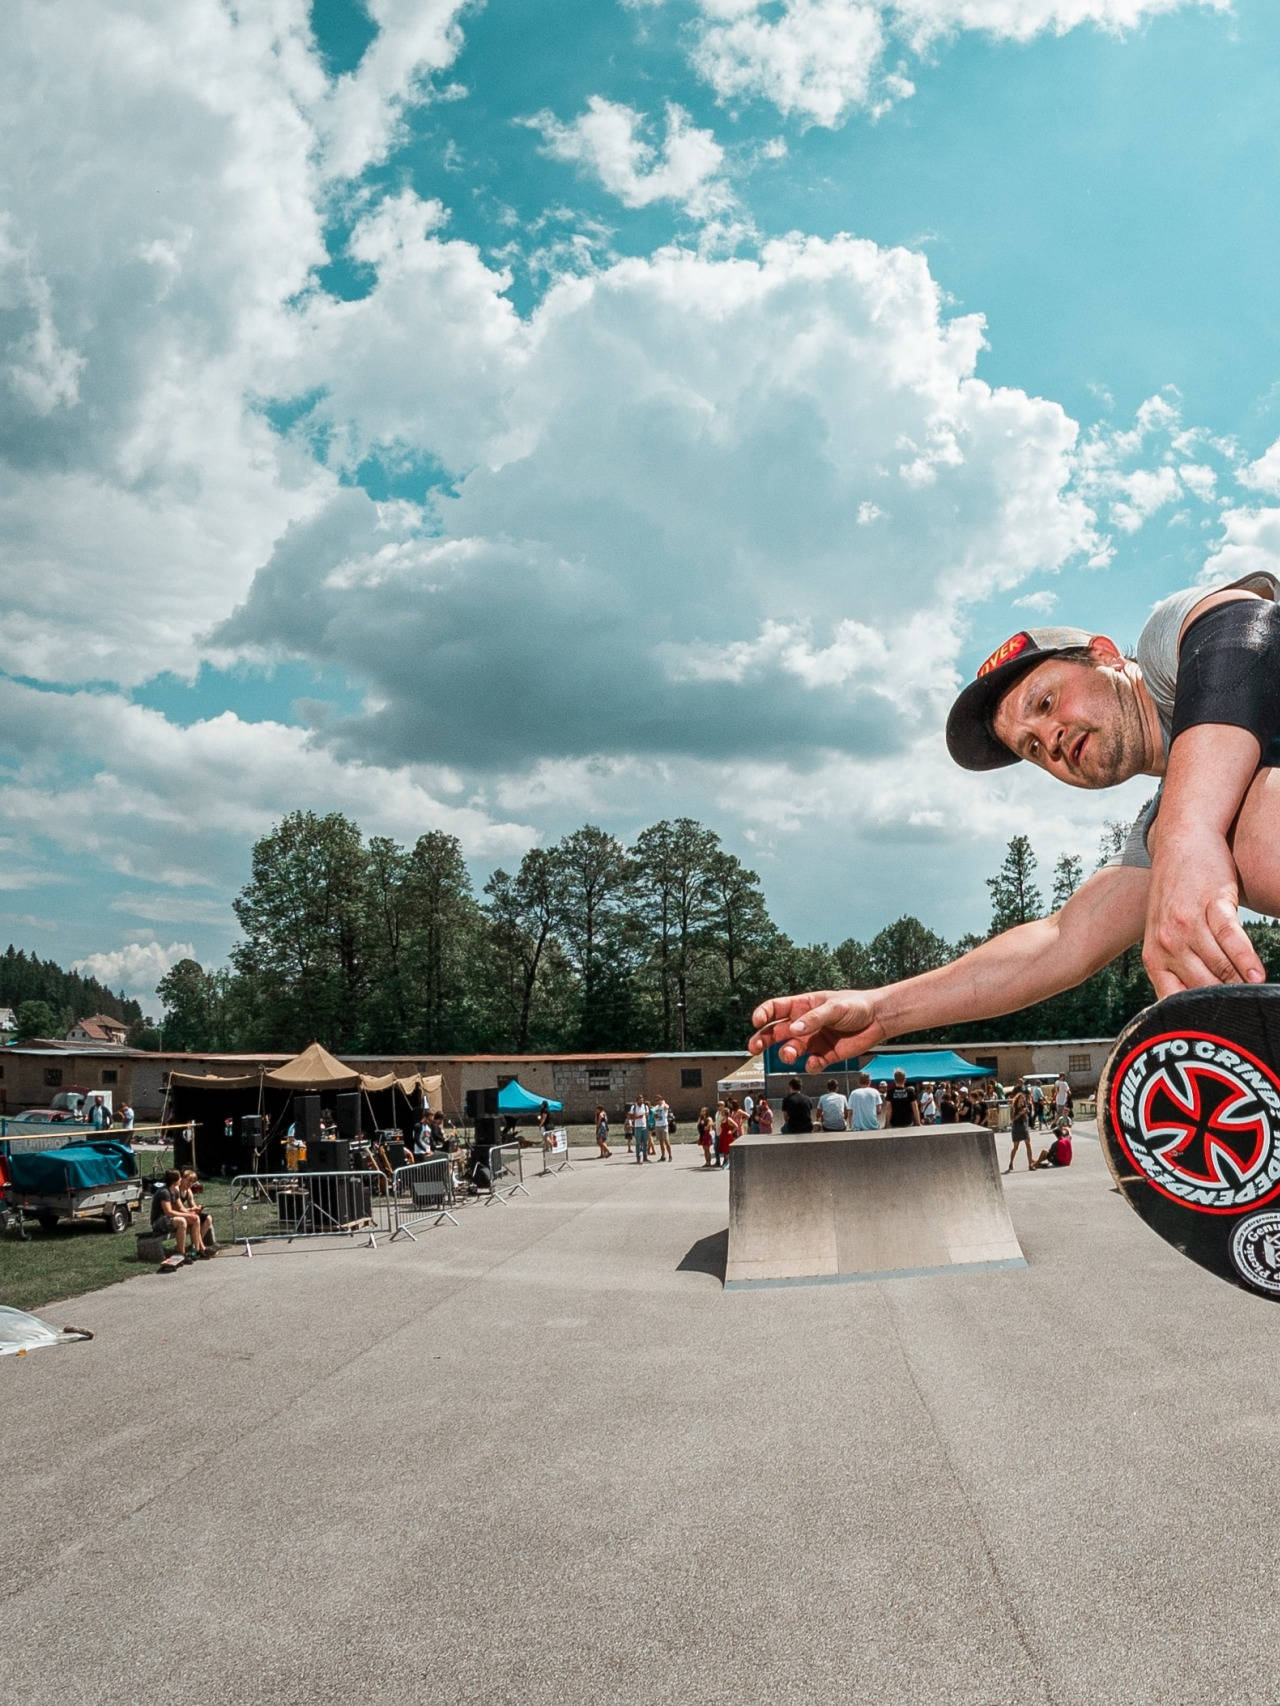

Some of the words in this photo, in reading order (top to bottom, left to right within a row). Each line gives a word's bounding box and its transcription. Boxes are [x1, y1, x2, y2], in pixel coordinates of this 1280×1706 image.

[1120, 1052, 1148, 1129] BUILT
[1151, 1039, 1188, 1062] TO
[1244, 1243, 1271, 1279] Picnic
